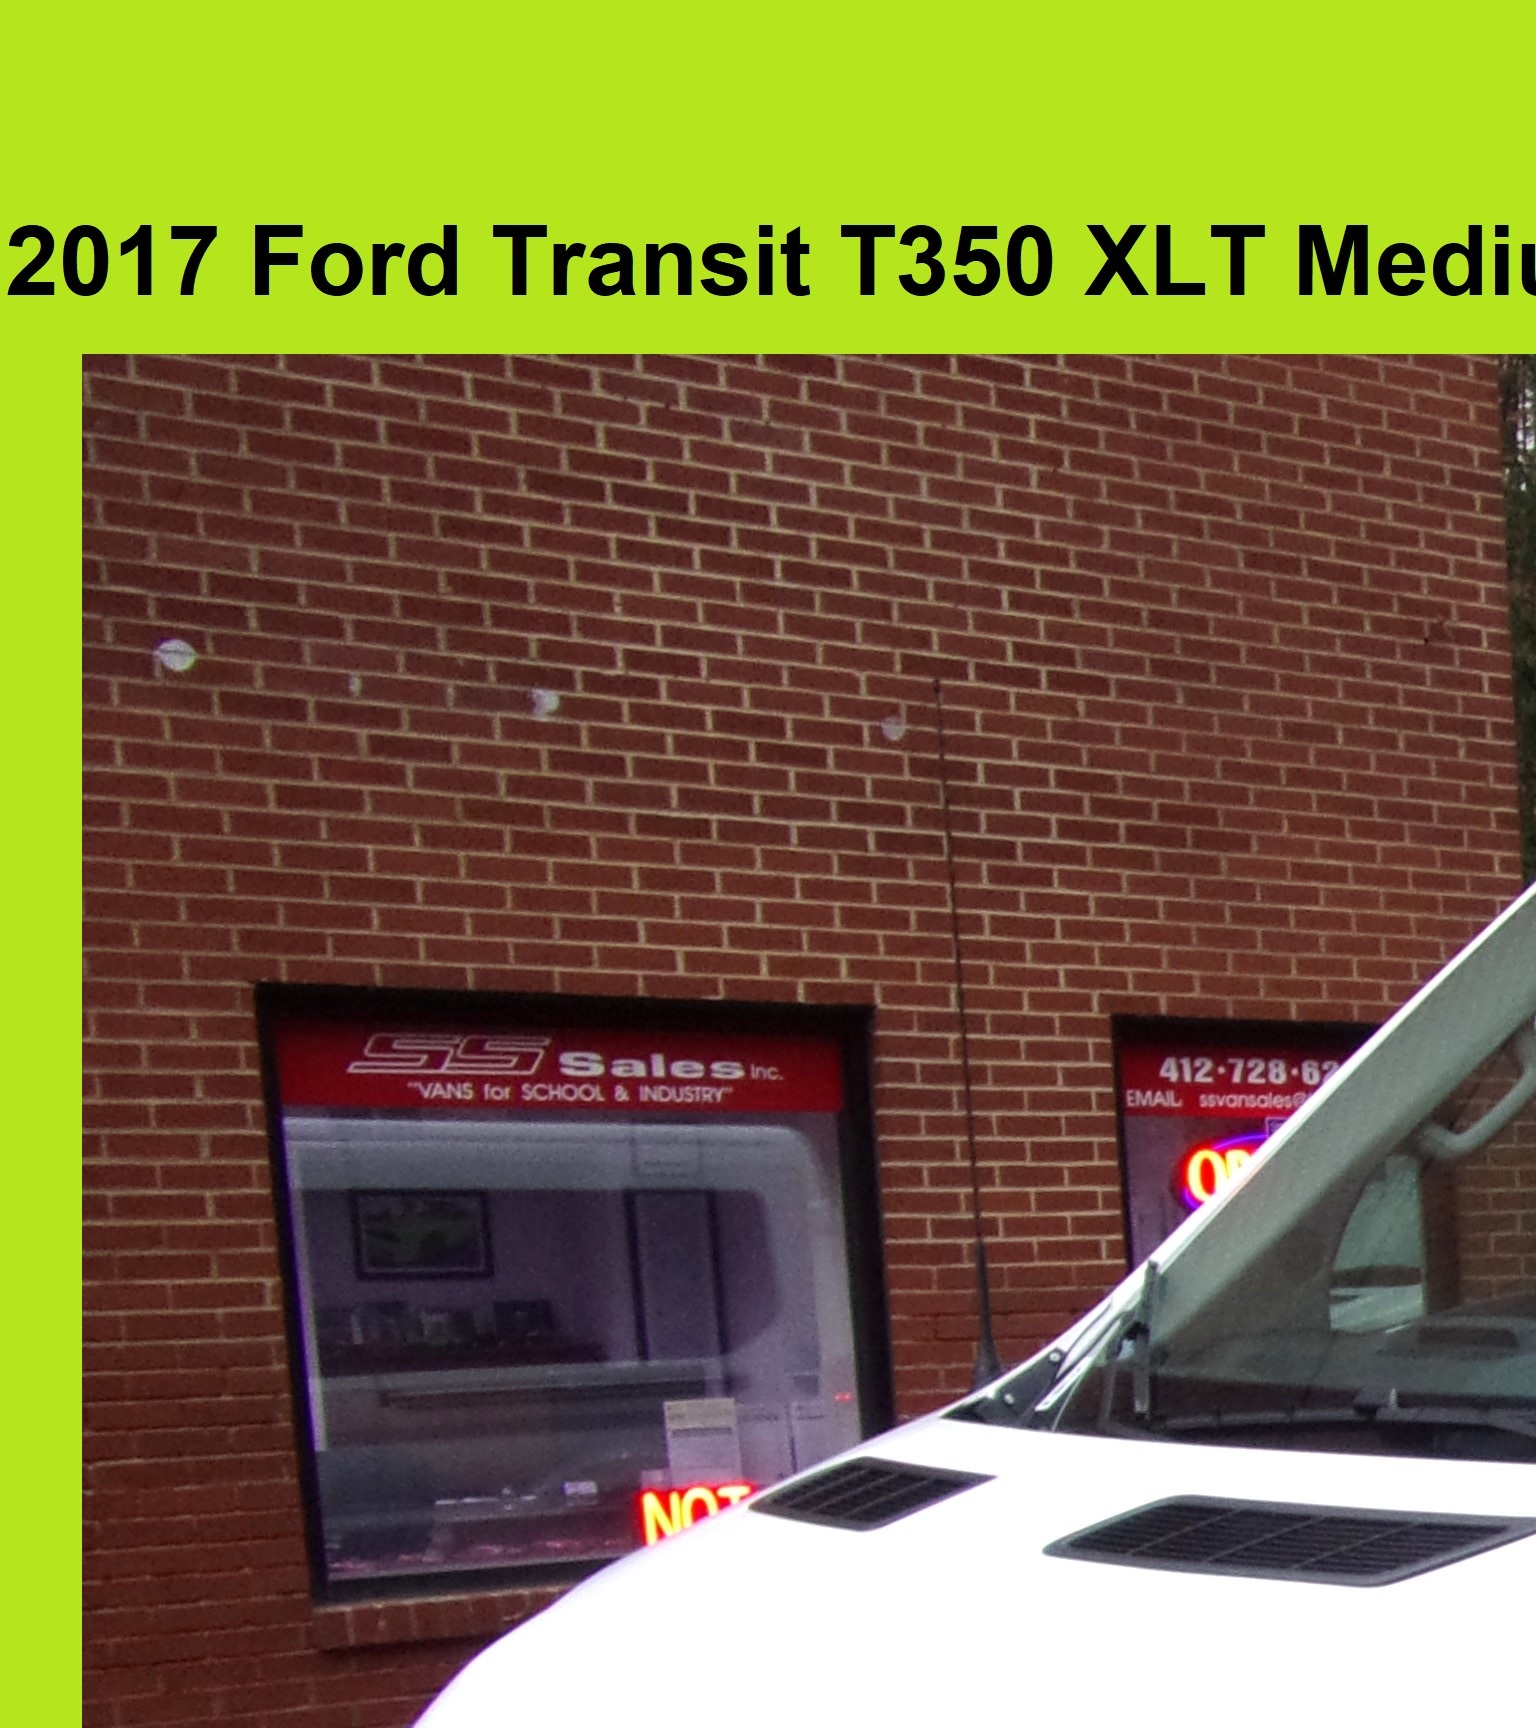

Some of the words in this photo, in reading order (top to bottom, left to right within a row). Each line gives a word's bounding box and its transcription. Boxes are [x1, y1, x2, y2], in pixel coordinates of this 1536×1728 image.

[347, 1032, 551, 1076] SS
[559, 1052, 744, 1080] Sales
[751, 1063, 784, 1082] Inc.
[484, 1083, 511, 1101] for
[521, 1083, 605, 1102] SCHOOL
[615, 1084, 629, 1102] &
[1200, 1091, 1310, 1110] ssvansales@
